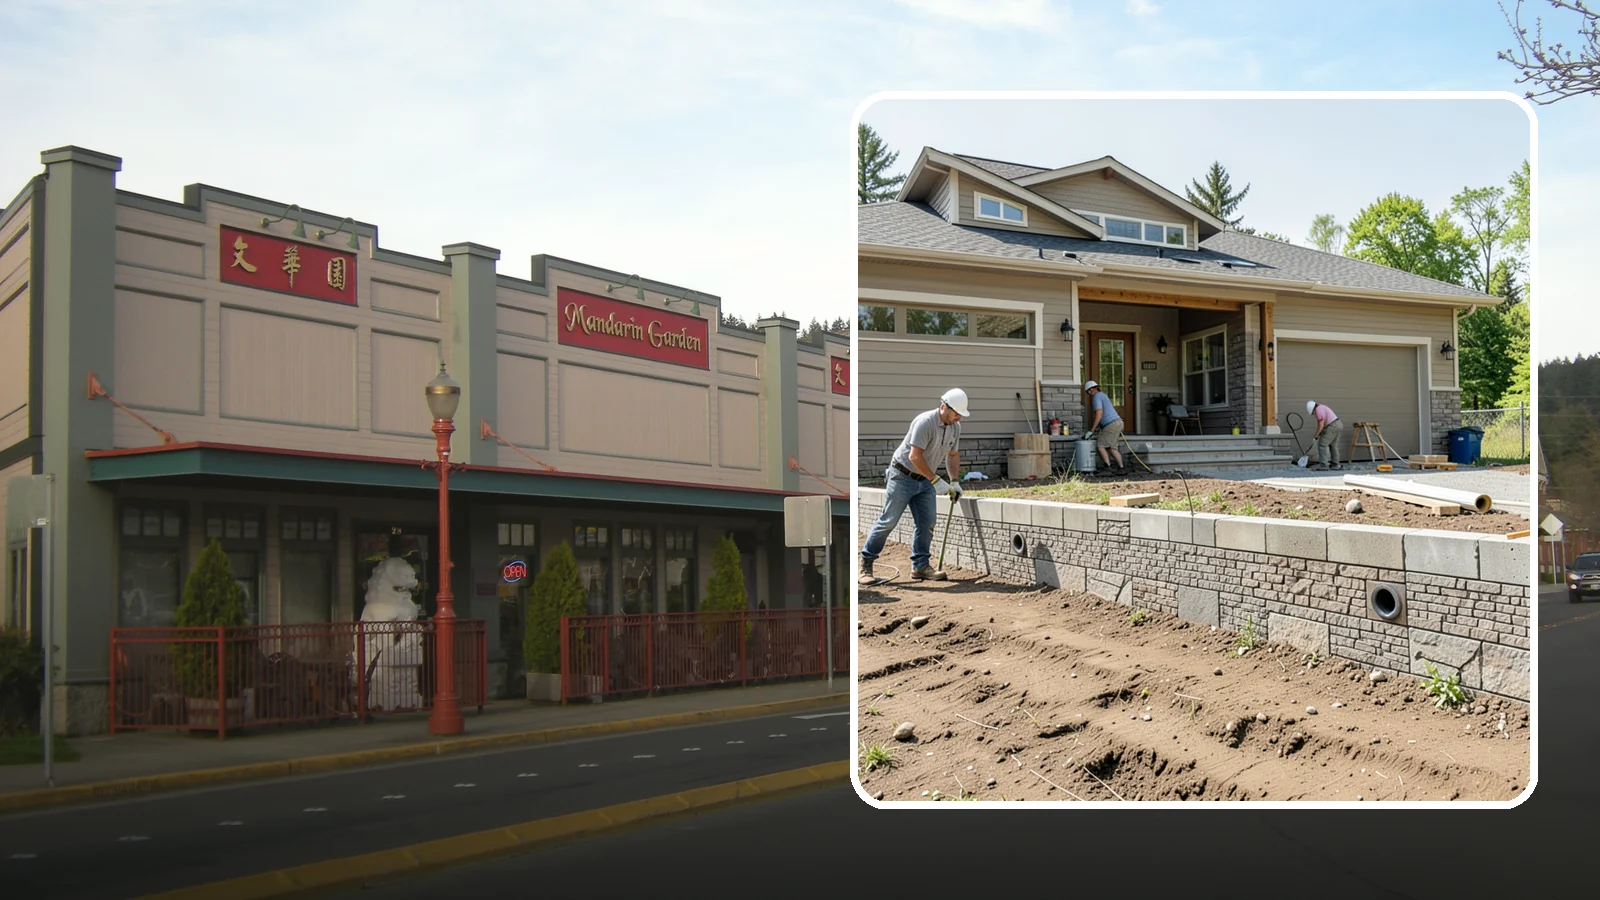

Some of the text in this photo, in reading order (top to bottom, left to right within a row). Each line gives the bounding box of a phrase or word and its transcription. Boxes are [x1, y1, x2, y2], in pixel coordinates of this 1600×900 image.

[231, 236, 346, 290] 文華園
[565, 303, 701, 352] Mandarin Garden
[503, 565, 527, 578] OPEN
